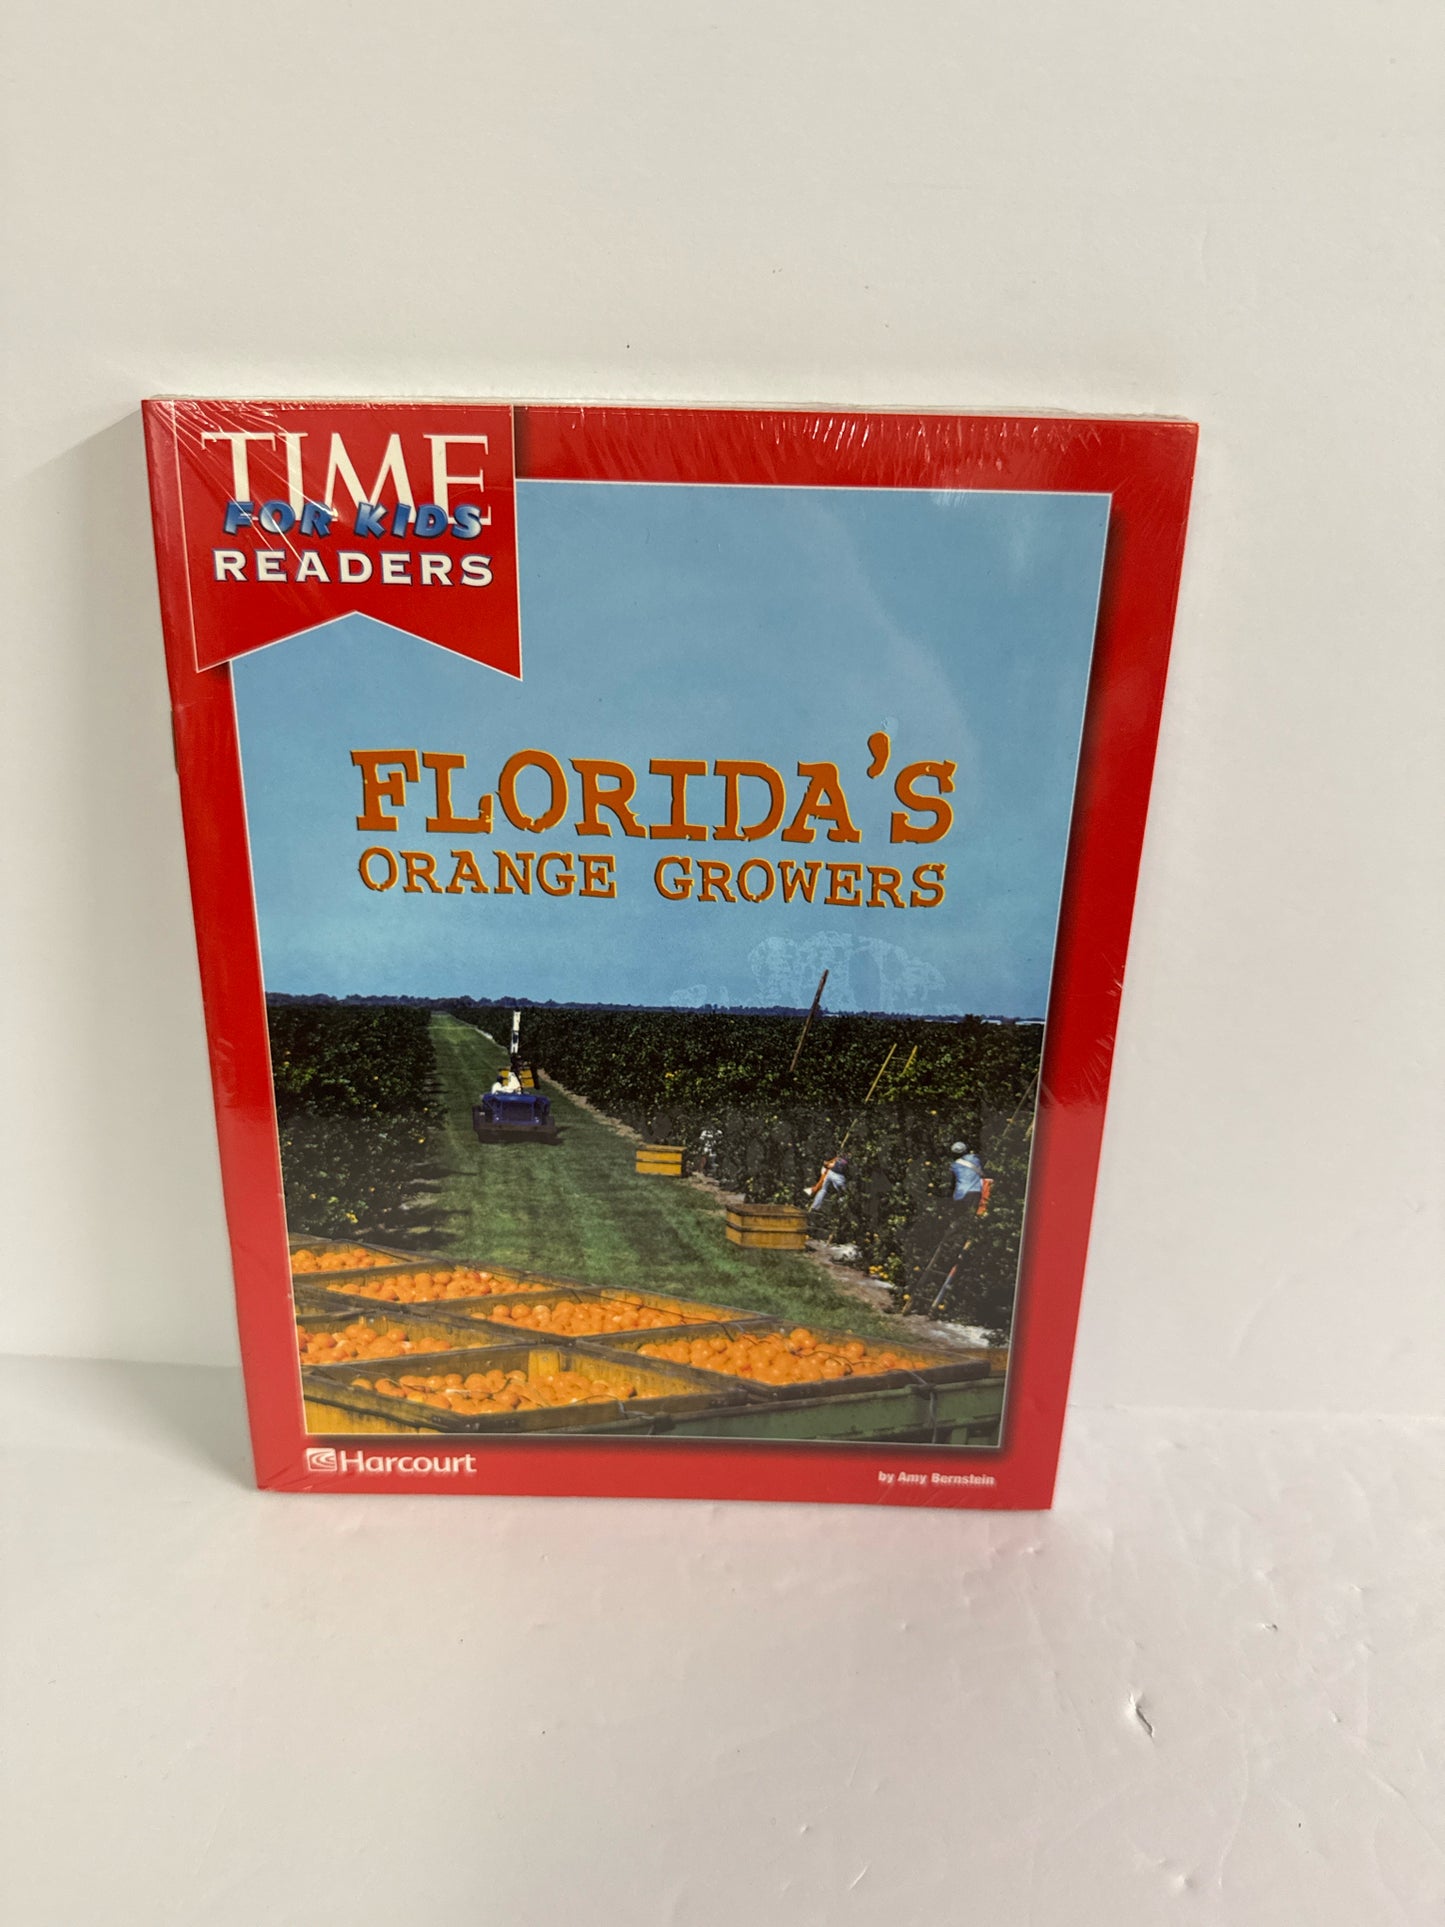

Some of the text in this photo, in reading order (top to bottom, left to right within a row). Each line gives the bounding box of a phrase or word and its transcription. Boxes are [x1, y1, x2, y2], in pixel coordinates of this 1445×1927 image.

[201, 431, 492, 526] TIME
[222, 500, 483, 539] FOR KIDS
[211, 548, 494, 588] READERS
[349, 731, 958, 844] FLORIDA'S
[357, 846, 948, 908] ORANGE GROWERS
[340, 1450, 477, 1473] Harcourt
[878, 1471, 996, 1486] by Amy Bernstein
